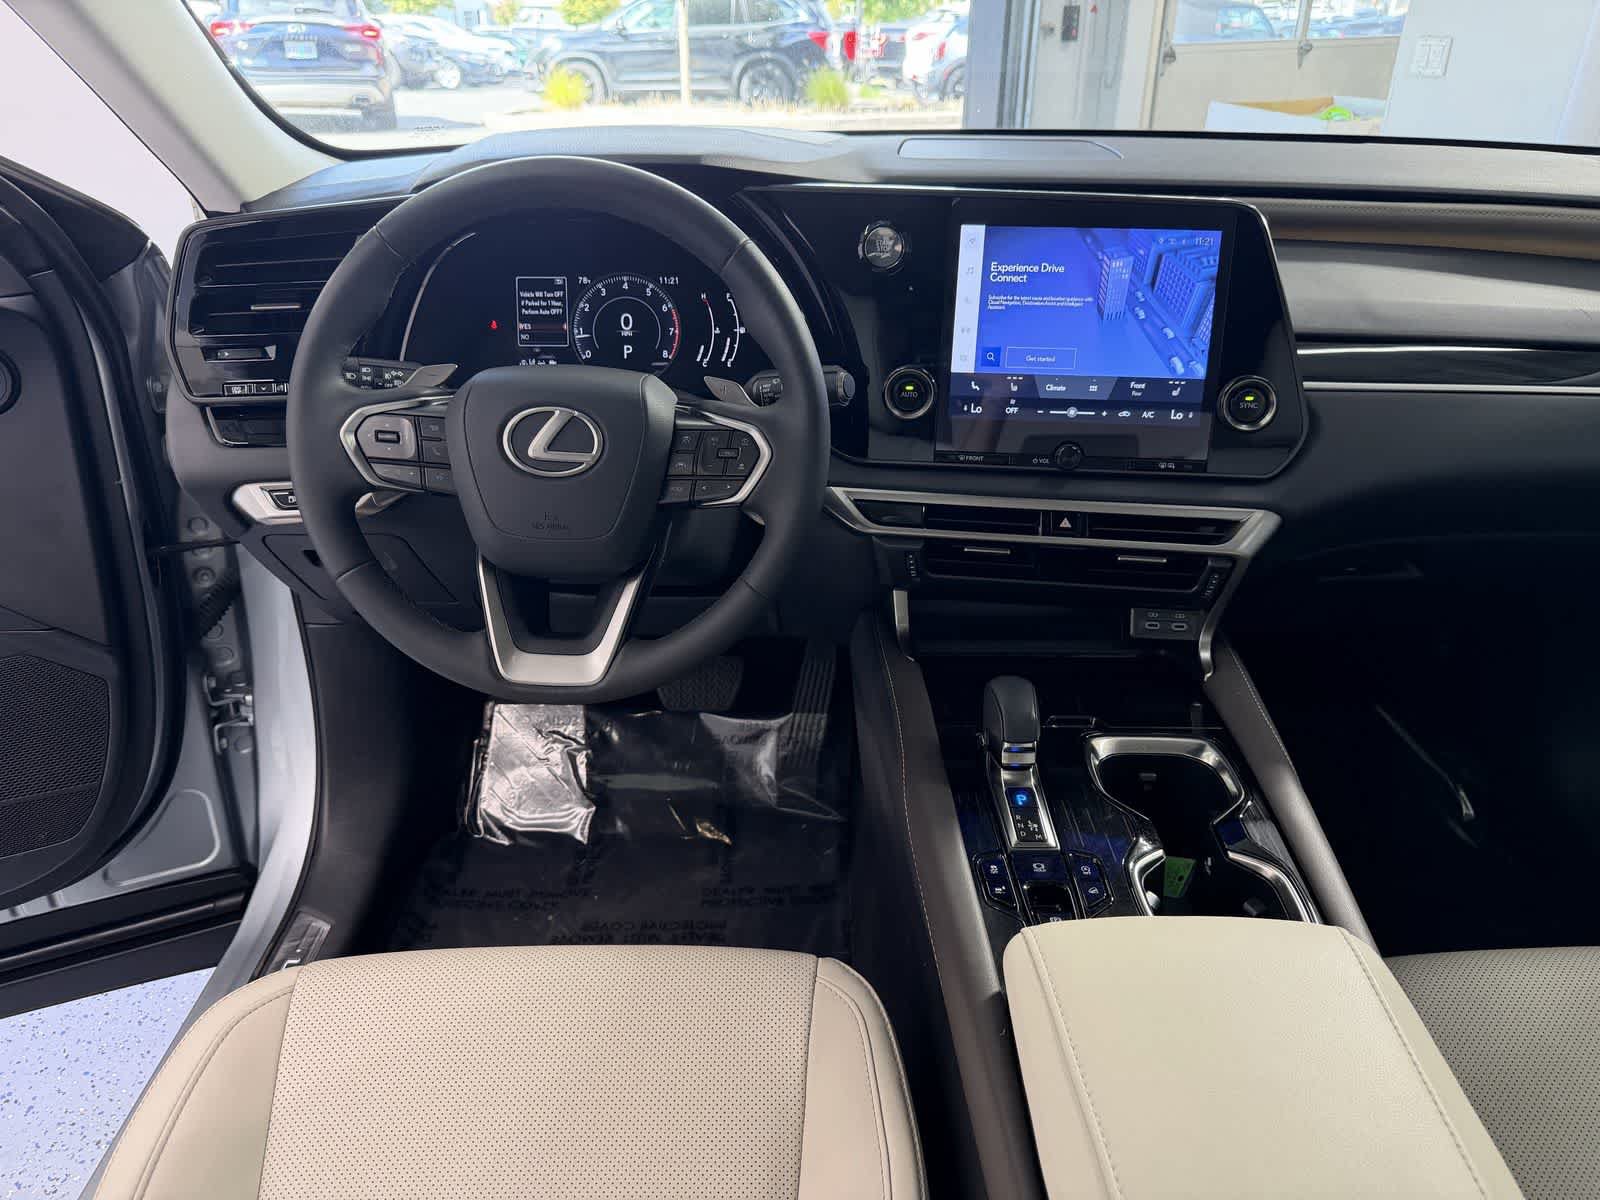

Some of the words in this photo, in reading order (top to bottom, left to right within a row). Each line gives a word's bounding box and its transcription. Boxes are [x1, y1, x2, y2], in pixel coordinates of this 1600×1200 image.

[990, 261, 1039, 274] Experience
[1041, 262, 1065, 273] Drive
[659, 276, 679, 285] 11:21
[990, 272, 1027, 283] Connect
[622, 282, 629, 290] 4
[600, 288, 606, 297] 3
[646, 288, 652, 297] 5
[584, 303, 590, 312] 2
[662, 304, 668, 312] 6
[620, 313, 633, 331] 0
[668, 327, 675, 336] 7
[585, 350, 592, 359] 0
[623, 344, 633, 360] P
[662, 350, 669, 359] 8
[1025, 354, 1036, 362] Get
[1037, 354, 1056, 362] started
[1045, 383, 1067, 392] Climate
[1130, 381, 1146, 389] Front
[970, 402, 983, 414] Lo
[1005, 406, 1019, 415] OFF
[1141, 410, 1155, 419] A/C
[1170, 409, 1184, 420] Lo
[965, 455, 985, 463] FRONT
[1015, 794, 1027, 806] P
